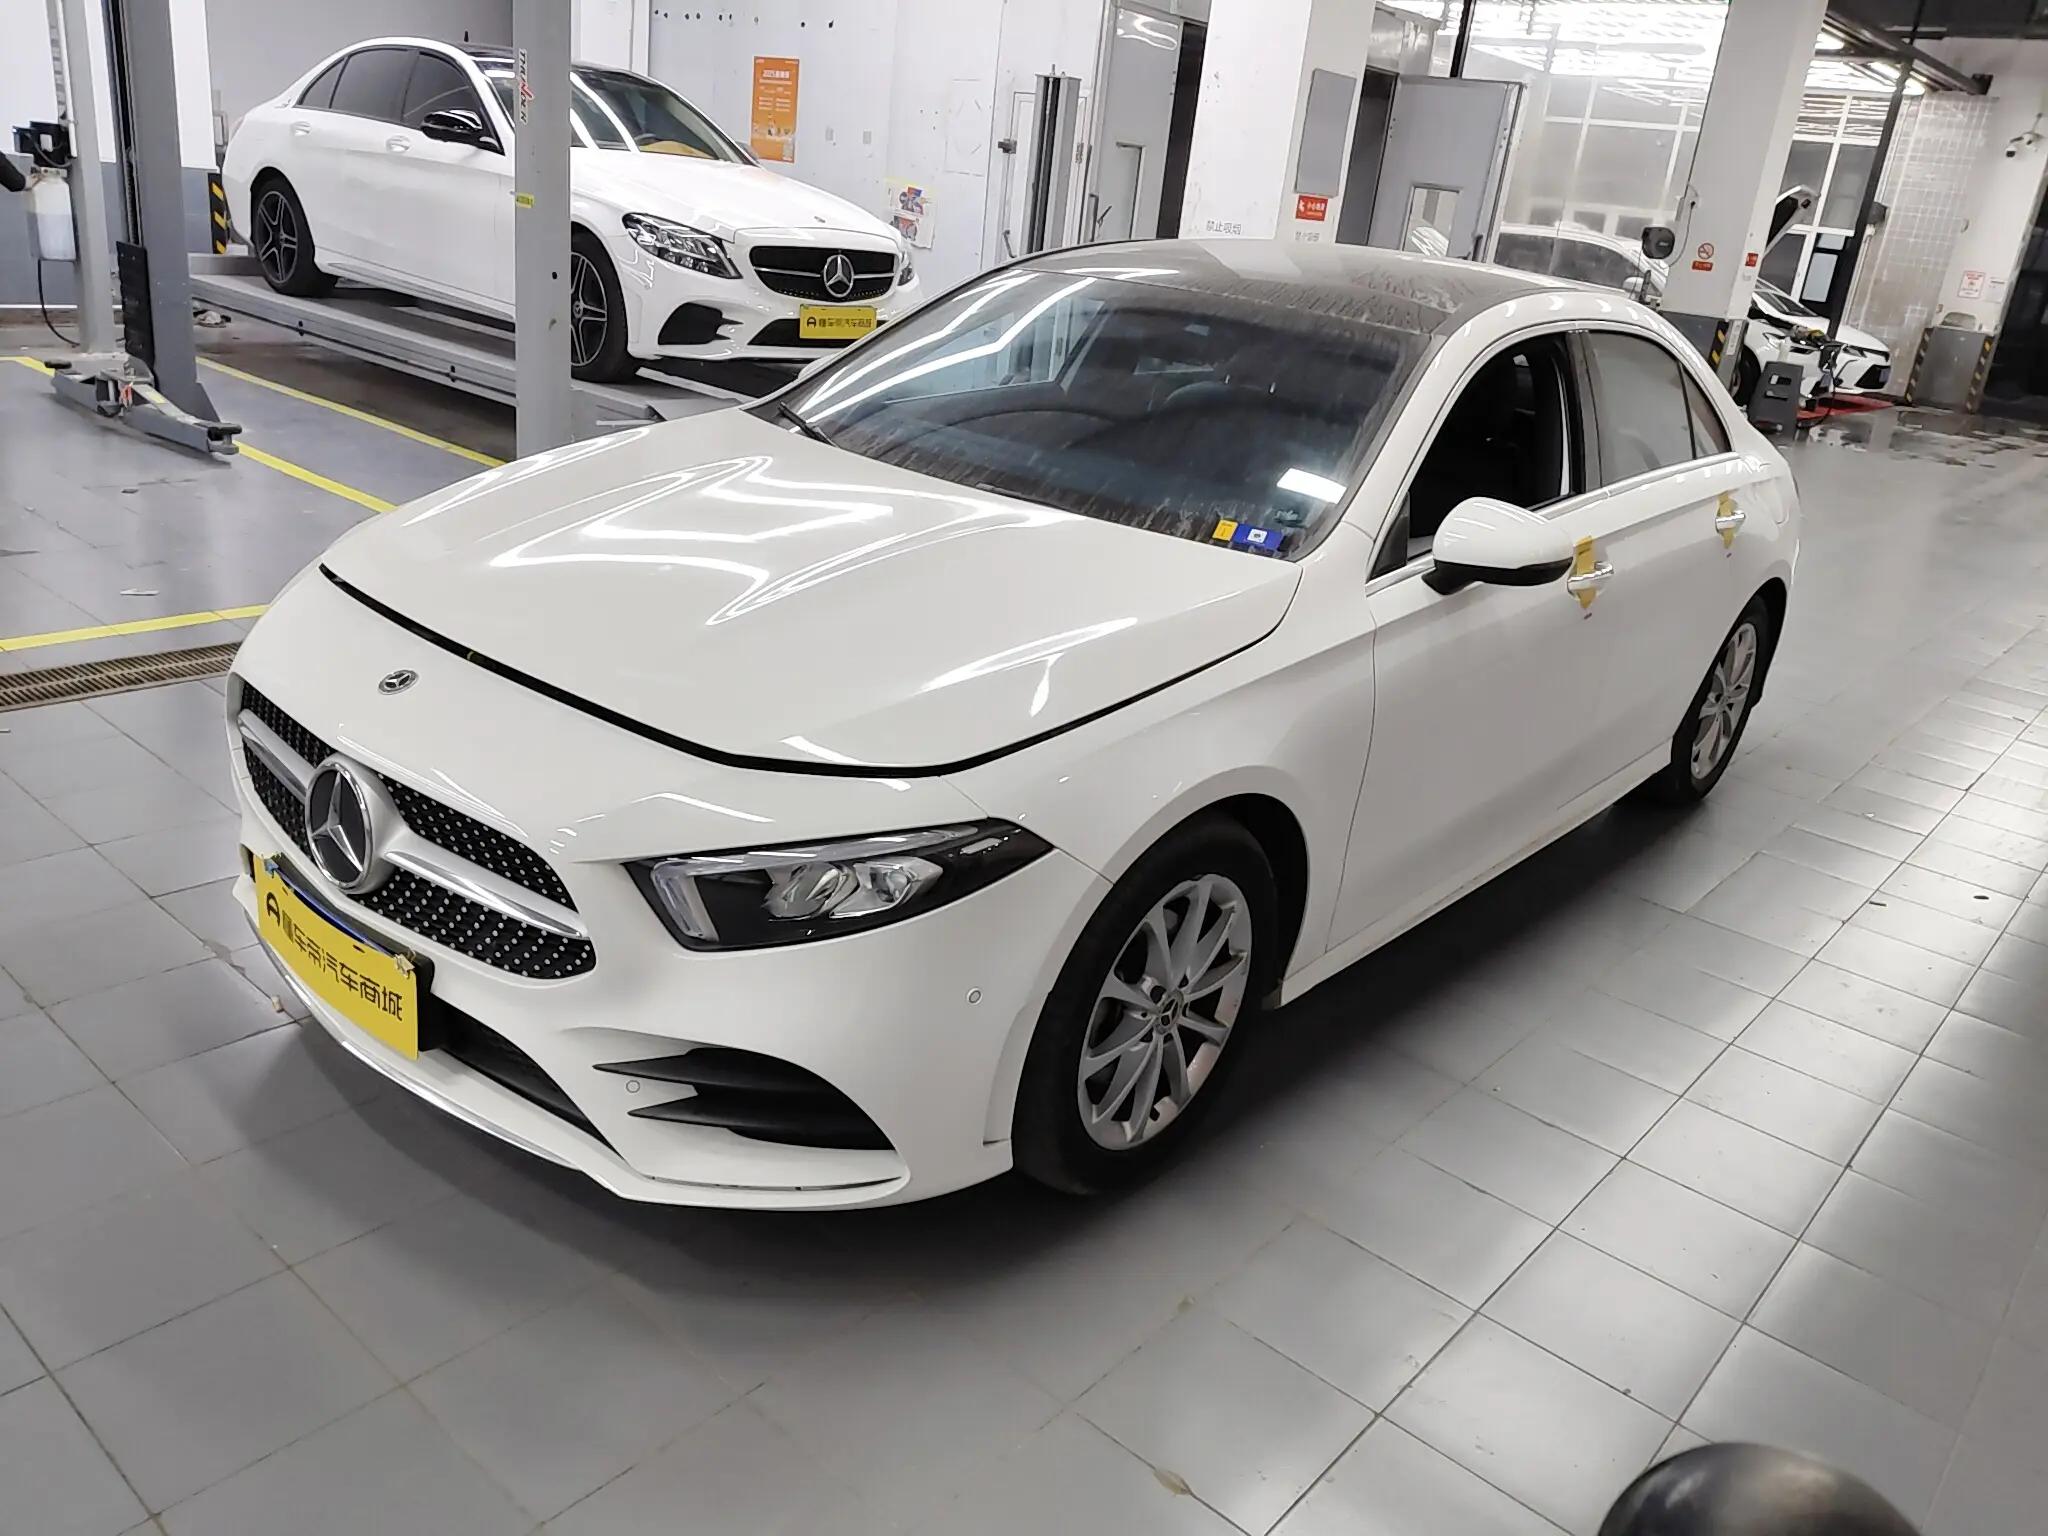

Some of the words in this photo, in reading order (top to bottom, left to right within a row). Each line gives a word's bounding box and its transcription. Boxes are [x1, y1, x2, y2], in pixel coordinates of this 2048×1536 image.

[818, 317, 873, 329] 懂车汽车
[282, 909, 404, 1022] 车帝汽车商城
